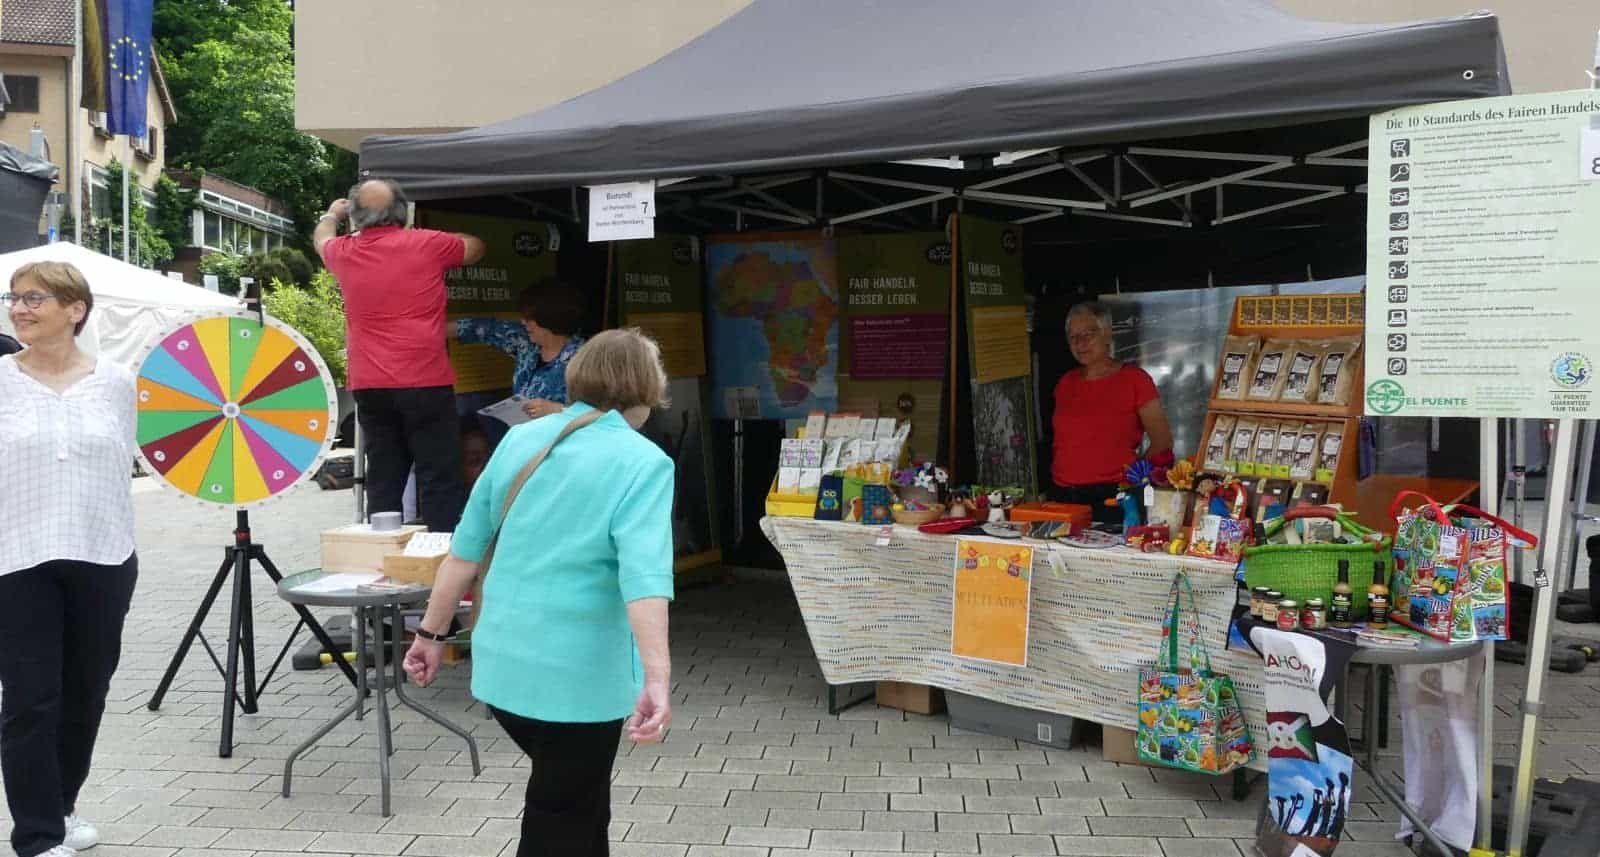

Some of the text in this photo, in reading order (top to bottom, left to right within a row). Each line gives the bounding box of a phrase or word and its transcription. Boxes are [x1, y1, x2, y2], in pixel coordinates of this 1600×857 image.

[1386, 119, 1403, 130] Die
[1408, 117, 1420, 127] 10
[1423, 110, 1481, 125] Standards
[1485, 108, 1504, 120] des
[1508, 105, 1547, 118] Fairen
[641, 202, 649, 214] 7
[849, 277, 870, 289] FAIR
[849, 293, 883, 305] BESSER
[1406, 397, 1469, 406] EL PUENTE
